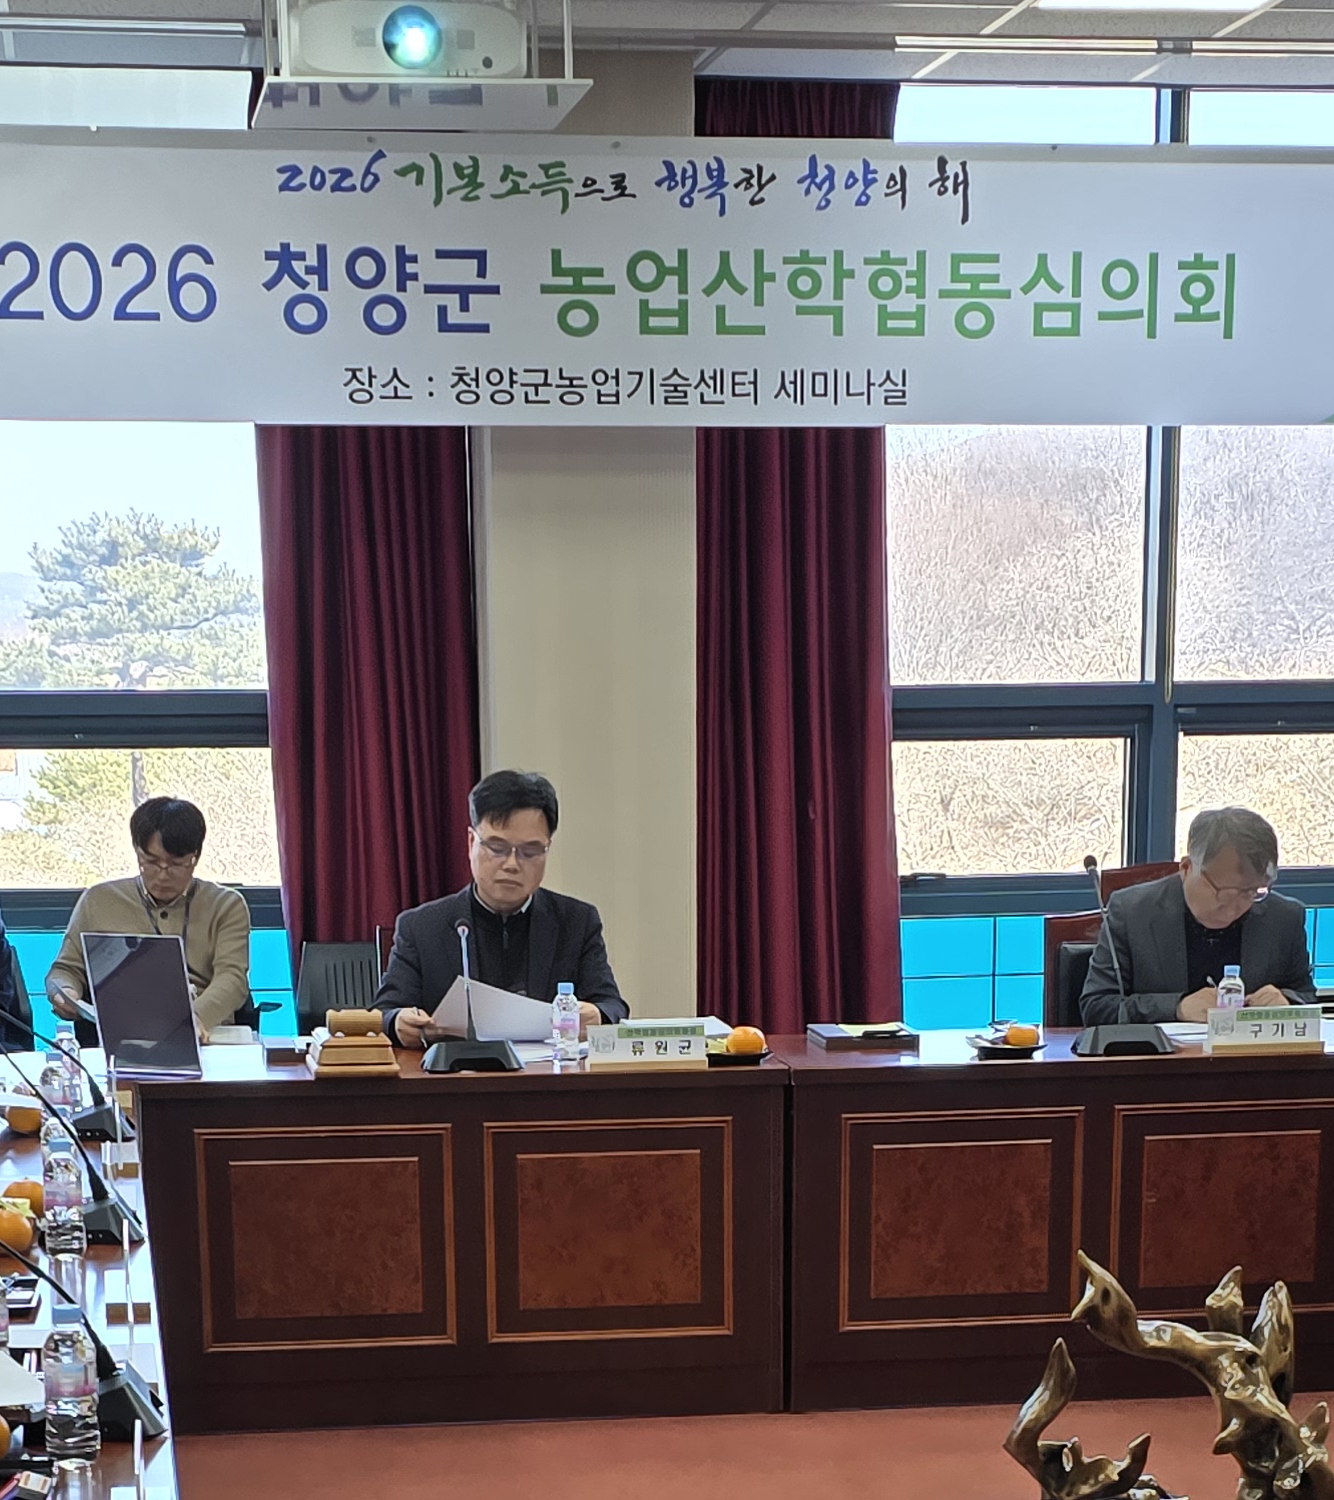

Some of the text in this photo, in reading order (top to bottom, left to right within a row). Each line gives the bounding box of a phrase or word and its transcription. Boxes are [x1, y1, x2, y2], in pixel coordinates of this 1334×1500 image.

[276, 149, 969, 225] 2026 기본소득으로 행복한 청양의 해
[261, 242, 501, 336] 청양군
[539, 247, 1236, 340] 농업산학협동심의회
[342, 365, 414, 406] 장소
[449, 365, 759, 407] 청양군농업기술센터
[772, 366, 910, 407] 세미나실
[1249, 1021, 1308, 1039] 구기남
